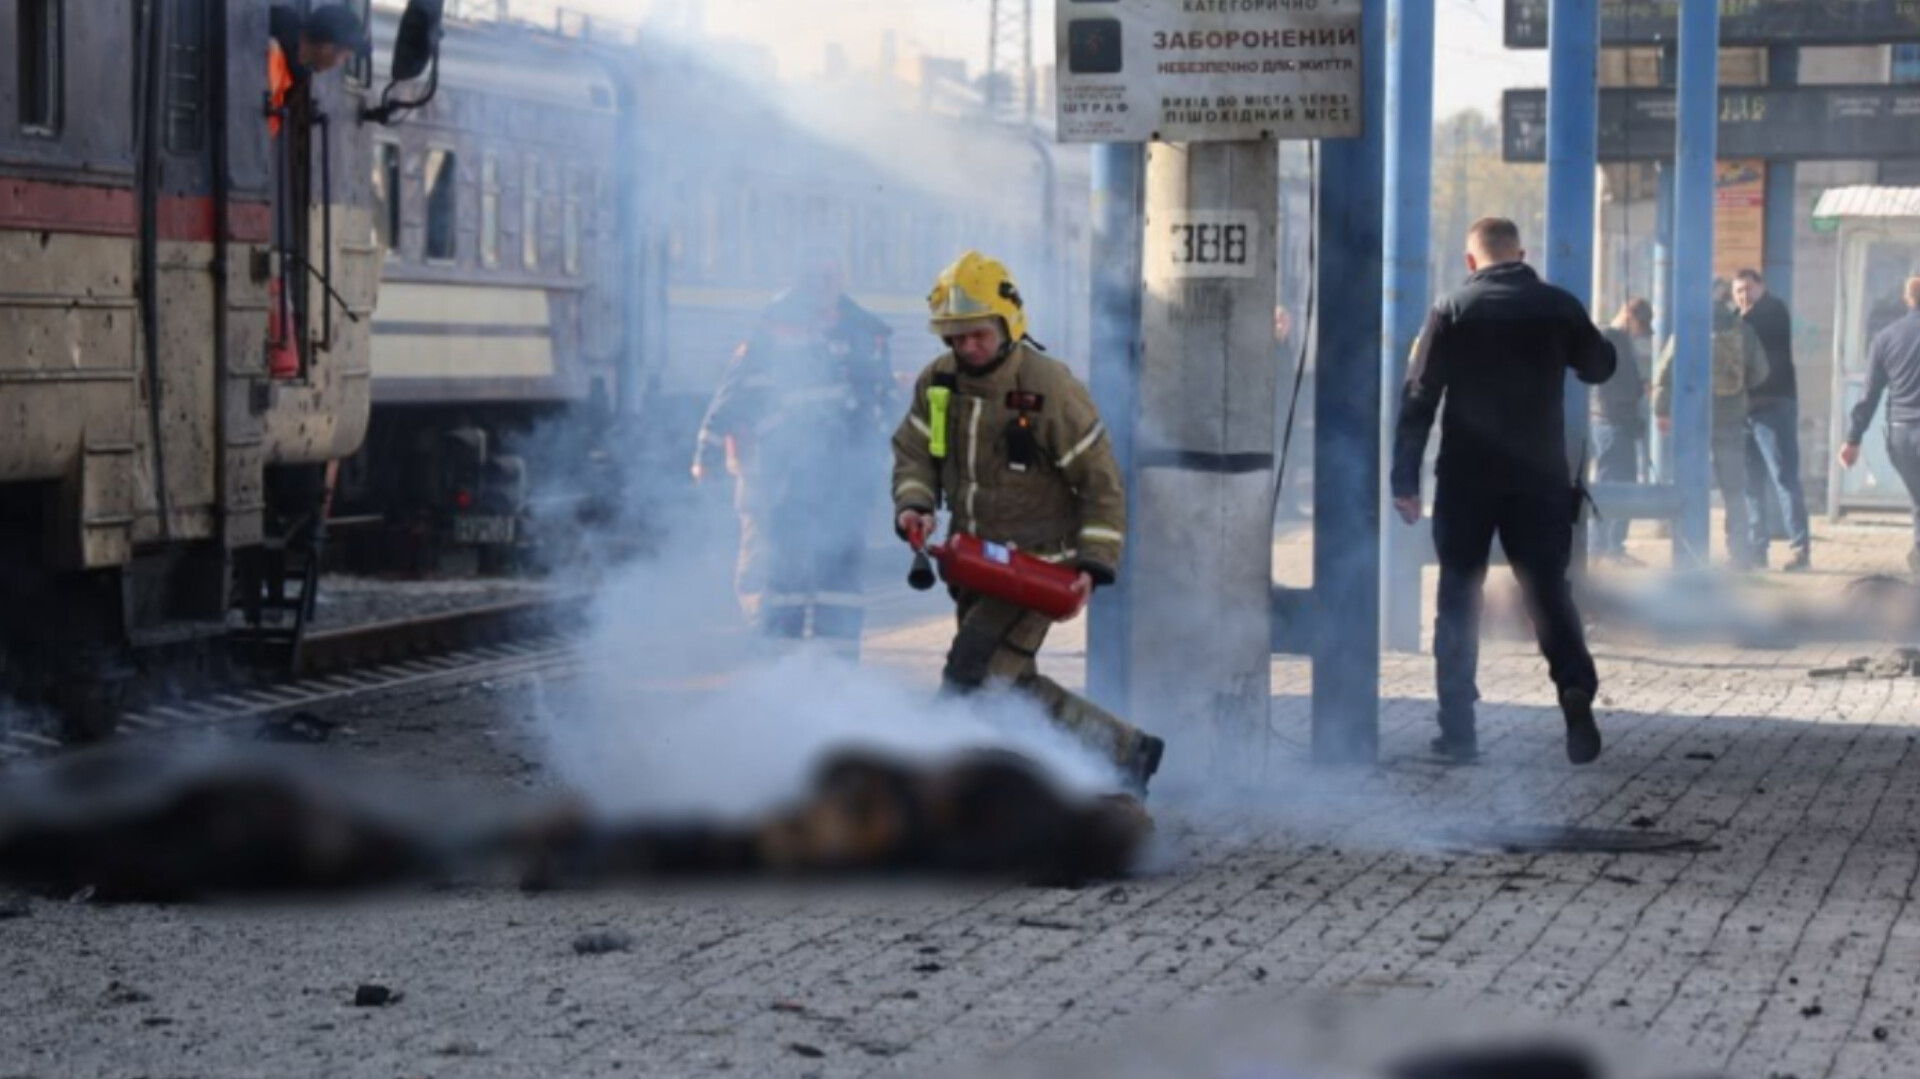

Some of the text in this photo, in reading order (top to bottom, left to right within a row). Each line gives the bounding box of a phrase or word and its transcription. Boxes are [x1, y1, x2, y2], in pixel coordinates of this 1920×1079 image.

[1182, 0, 1318, 13] КАТЕГОРИЧНО
[1157, 61, 1258, 74] НЕБЕЗПЕЧНО
[1063, 102, 1129, 114] ШТРАФ
[1304, 107, 1351, 121] МІСТ
[1171, 223, 1247, 265] 388
